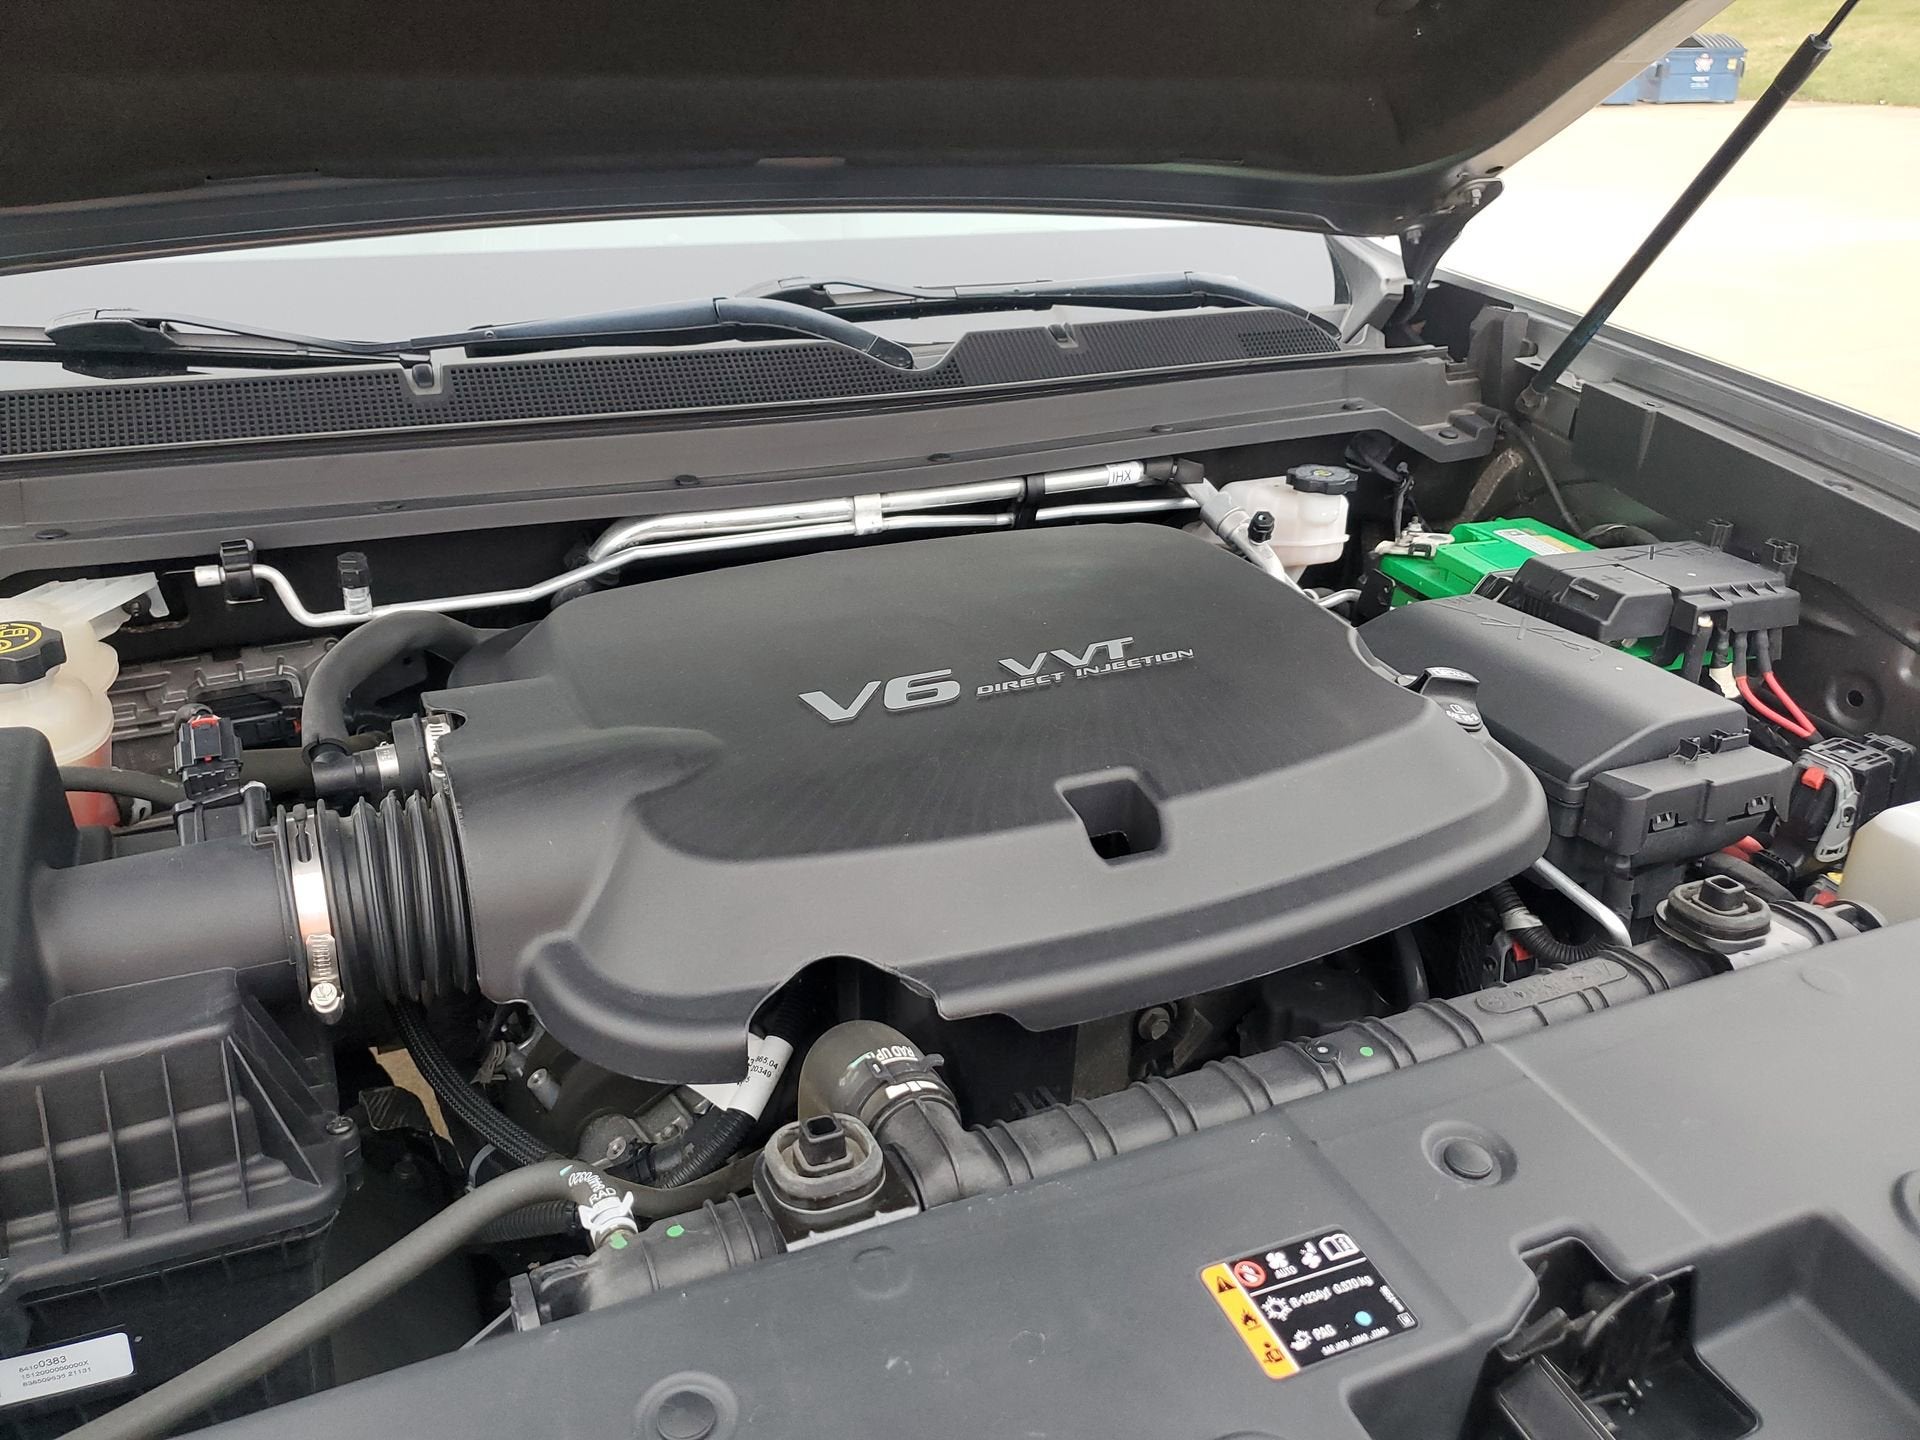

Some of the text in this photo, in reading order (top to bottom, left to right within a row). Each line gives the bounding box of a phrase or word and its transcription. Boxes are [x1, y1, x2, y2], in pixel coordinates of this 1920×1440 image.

[997, 636, 1134, 677] VVT
[975, 648, 1195, 697] DIRECT INJECTION
[797, 667, 961, 724] V6
[589, 1187, 617, 1205] RAD
[1275, 1265, 1298, 1279] AUTO
[1312, 1324, 1337, 1341] PAG
